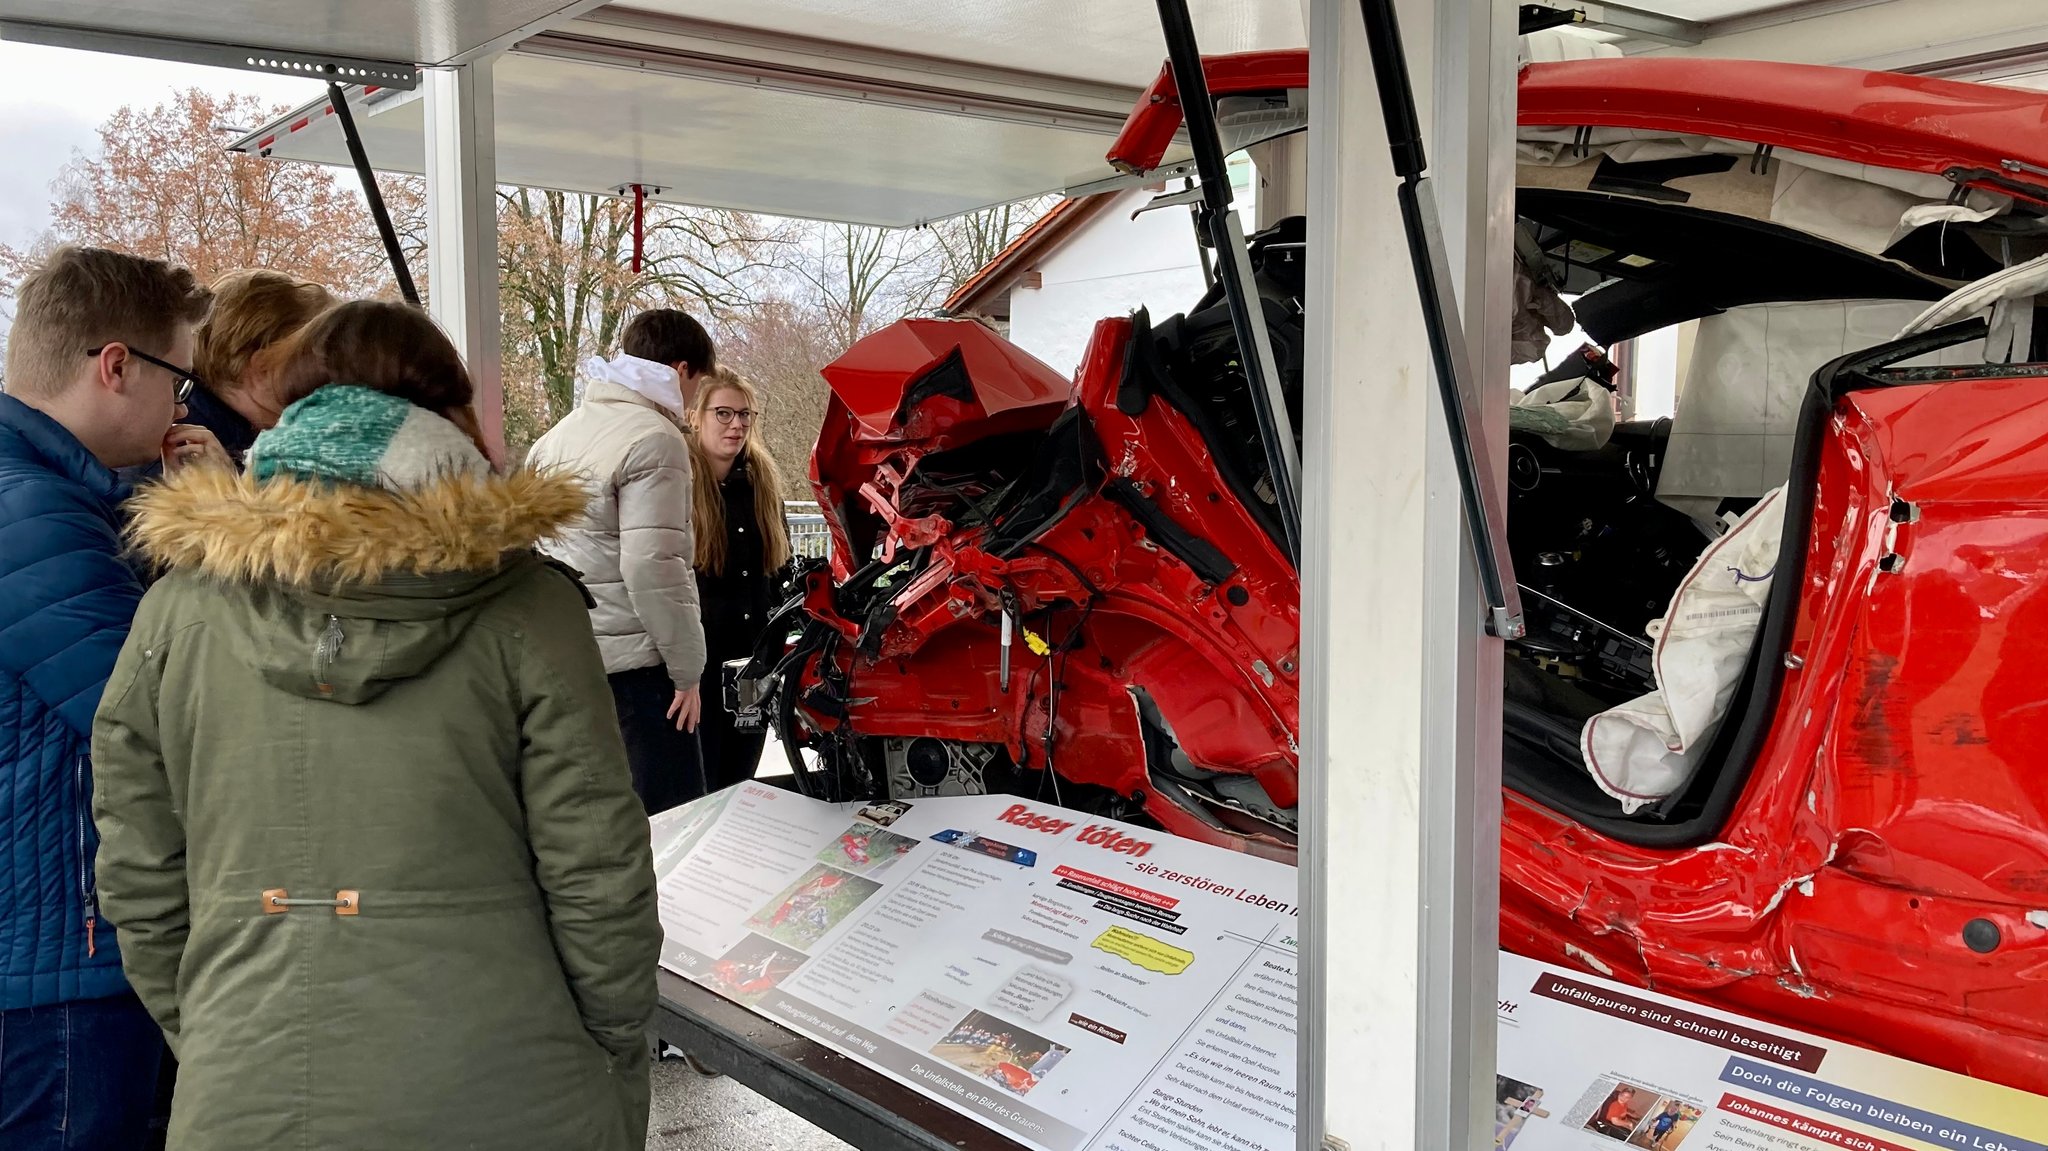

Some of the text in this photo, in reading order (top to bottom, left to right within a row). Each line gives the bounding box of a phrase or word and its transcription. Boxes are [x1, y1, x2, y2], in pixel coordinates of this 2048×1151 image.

[997, 804, 1154, 857] Raser töten
[1067, 870, 1100, 886] Raserunfall
[1101, 880, 1122, 893] schlägt
[1122, 886, 1139, 898] hohe
[1139, 891, 1162, 904] Wellen
[1134, 861, 1160, 875] sie
[1158, 869, 1235, 897] zerstören
[1235, 889, 1289, 913] Leben
[1160, 921, 1184, 934] Wahrheit
[1253, 972, 1276, 983] erfährt
[1263, 960, 1284, 973] Beate
[1234, 993, 1295, 1019] Gedanken schwirren
[1244, 982, 1278, 999] Ihre Familie
[776, 1000, 879, 1055] Rettungskräfte sind auf dem Weg
[1215, 1016, 1230, 1026] und
[1225, 1004, 1236, 1012] Sie
[1235, 1008, 1262, 1021] versucht
[1261, 1017, 1278, 1028] ihren
[1551, 982, 1802, 1062] Unfallspuren sind schnell beseitigt
[1195, 1038, 1206, 1047] Sie
[1205, 1043, 1229, 1056] erkennt
[1228, 1051, 1242, 1060] den
[1241, 1056, 1257, 1067] Opel
[1215, 1030, 1244, 1046] Unfallbild
[1175, 1062, 1297, 1116] Die Gefühle kann sie bis heute nicht besc
[1210, 1060, 1223, 1069] wie
[1223, 1065, 1234, 1073] im
[1233, 1069, 1259, 1083] leeren
[1258, 1078, 1283, 1093] Raum,
[1282, 1089, 1297, 1099] als
[910, 1063, 1046, 1135] Die Unfallstelle, ein Bild des Grauens
[1152, 1088, 1203, 1114] Bange Stunden
[1165, 1073, 1181, 1084] Sehr
[1180, 1080, 1194, 1090] bald
[1192, 1086, 1209, 1096] nach
[1208, 1092, 1224, 1102] dem
[1222, 1098, 1242, 1110] Unfall
[1241, 1106, 1265, 1120] erfährt
[1264, 1115, 1275, 1124] sie
[1274, 1120, 1290, 1130] vom
[1731, 1065, 2016, 1151] Doch die Folgen bleiben ein Leb
[1118, 1129, 1162, 1151] Tochter Celina
[1130, 1113, 1209, 1151] Aufgrund der Verletzungen
[1138, 1105, 1223, 1146] Erst Stunden später kann sie
[1160, 1102, 1171, 1111] ist
[1170, 1107, 1187, 1119] mein
[1186, 1114, 1206, 1128] Sohn,
[1206, 1123, 1222, 1134] lebt
[1220, 1131, 1231, 1139] er,
[1230, 1134, 1251, 1147] kann
[1250, 1142, 1263, 1151] ich
[1713, 1130, 1770, 1151] Sein Bein ist
[1719, 1118, 1776, 1143] Stundenlang
[1775, 1136, 1800, 1150] ringt
[1727, 1099, 1876, 1151] Johannes kämpft sich
